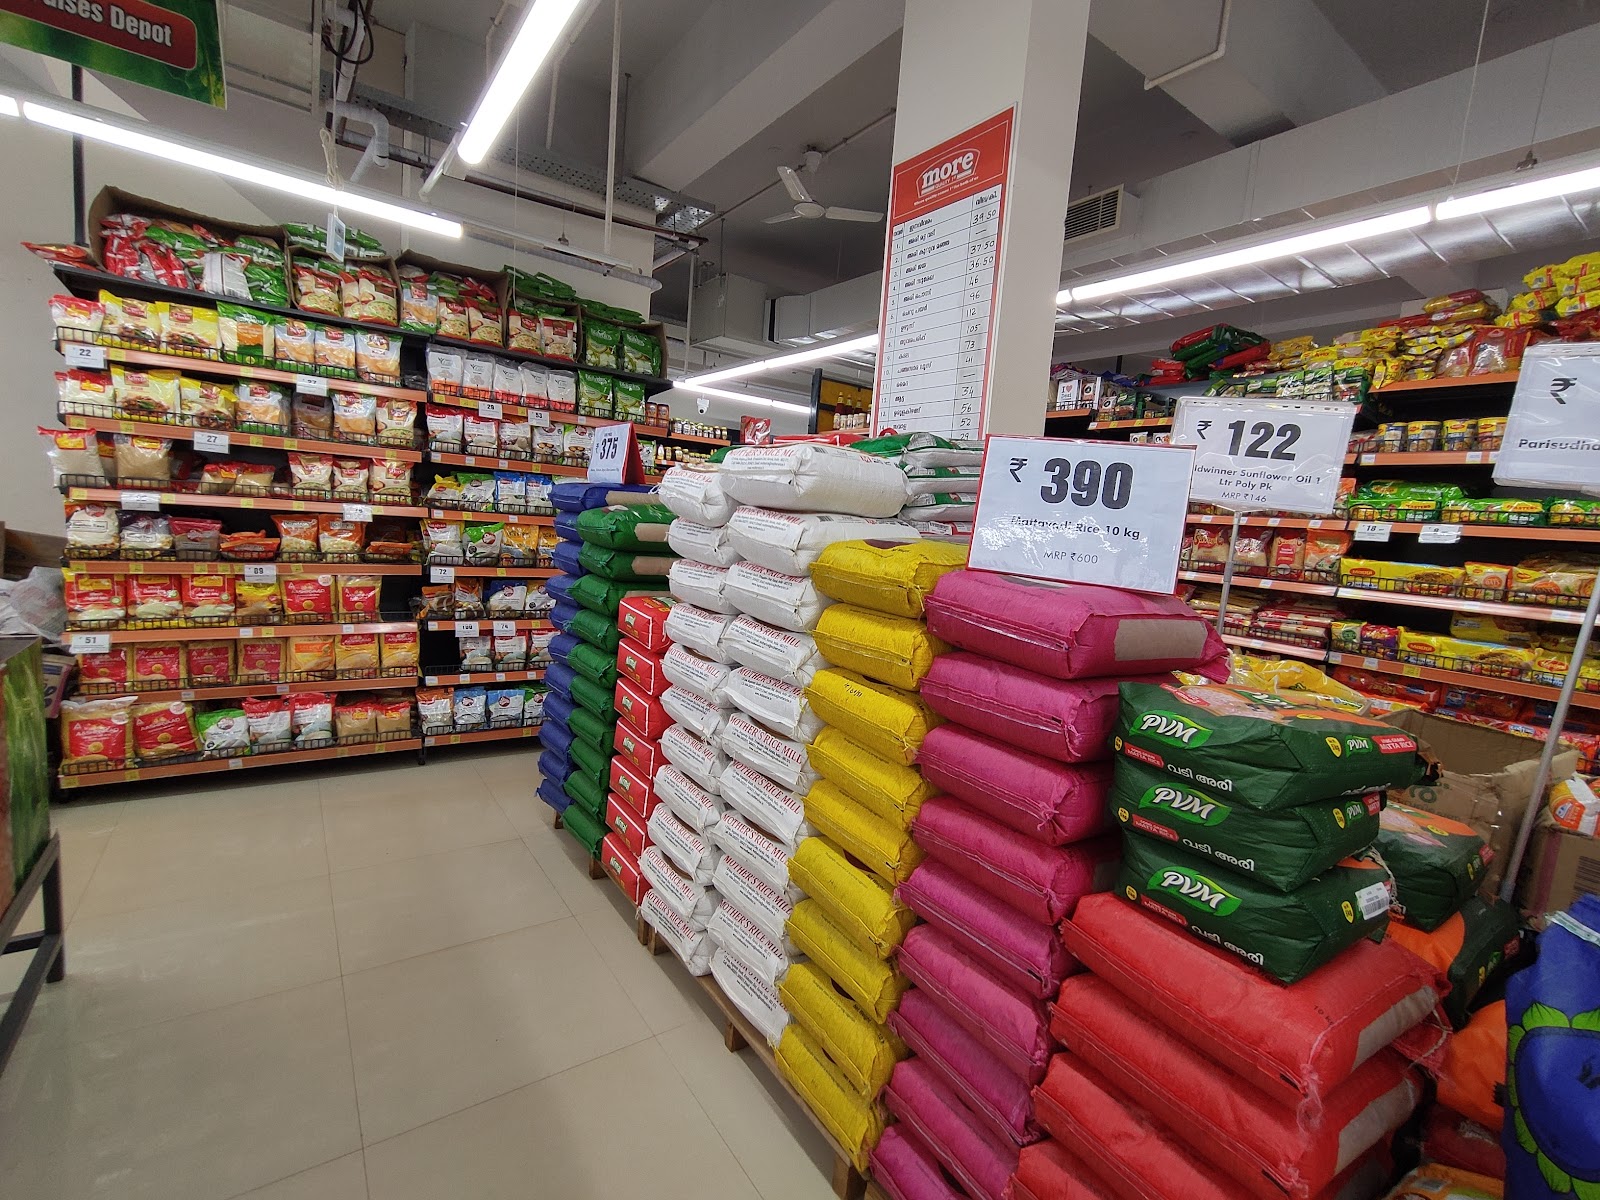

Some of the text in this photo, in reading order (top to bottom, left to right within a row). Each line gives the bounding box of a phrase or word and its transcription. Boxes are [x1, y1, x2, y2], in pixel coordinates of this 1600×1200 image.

[110, 5, 172, 47] Depot
[922, 152, 974, 189] more
[969, 275, 978, 286] 46
[970, 290, 980, 300] 96
[967, 308, 976, 317] 112
[967, 323, 981, 334] 105
[79, 349, 92, 357] 22
[965, 340, 975, 350] 73
[962, 386, 974, 398] 34
[1550, 377, 1577, 405] ₹
[961, 402, 972, 414] 56
[960, 417, 971, 427] 52
[600, 436, 619, 460] 375
[1197, 420, 1302, 461] ₹ 122
[1009, 457, 1134, 510] ₹ 390
[1219, 478, 1272, 491] Ltr Poly Pk
[1240, 469, 1292, 481] Sunflower
[1295, 475, 1311, 484] Oil
[1317, 477, 1321, 485] 1
[1221, 492, 1267, 503] MRP ₹146
[1075, 523, 1100, 534] Rice
[1105, 525, 1120, 536] 10
[1123, 527, 1141, 541] kg
[1043, 551, 1099, 564] MRP ₹600
[764, 626, 782, 639] RICE
[781, 634, 801, 648] MILL
[693, 657, 706, 670] RICE
[706, 665, 719, 678] MILL
[729, 715, 764, 744] MOTHER'S
[762, 733, 783, 752] RICE
[782, 745, 802, 764] MILL
[1140, 714, 1198, 743] PVM
[1347, 739, 1369, 750] PVM
[1380, 741, 1414, 750] MATTA RICE
[663, 765, 714, 811] MOTHER'S RICE MILL
[732, 759, 767, 786] MOTHER'S
[764, 778, 784, 799] RICE
[782, 794, 802, 815] MILL
[1167, 763, 1233, 792] വടി അരി
[1152, 788, 1216, 819] PVM
[1346, 804, 1362, 819] PVM
[656, 807, 680, 833] MOTHER'S
[678, 825, 691, 842] RICE
[691, 836, 705, 854] MILL
[722, 813, 756, 840] MOTHER'S
[754, 831, 774, 852] RICE
[1182, 838, 1255, 871] വടി അരി
[646, 849, 695, 901] MOTHER'S RICE MILL
[723, 855, 793, 915] MOTHER'S RICE MILL
[1161, 871, 1226, 909] PVM
[645, 891, 697, 942] MOTHER'S RICE MILL
[719, 899, 784, 960] MOTHER'S RICE MILL
[1191, 925, 1264, 965] വടി അരി
